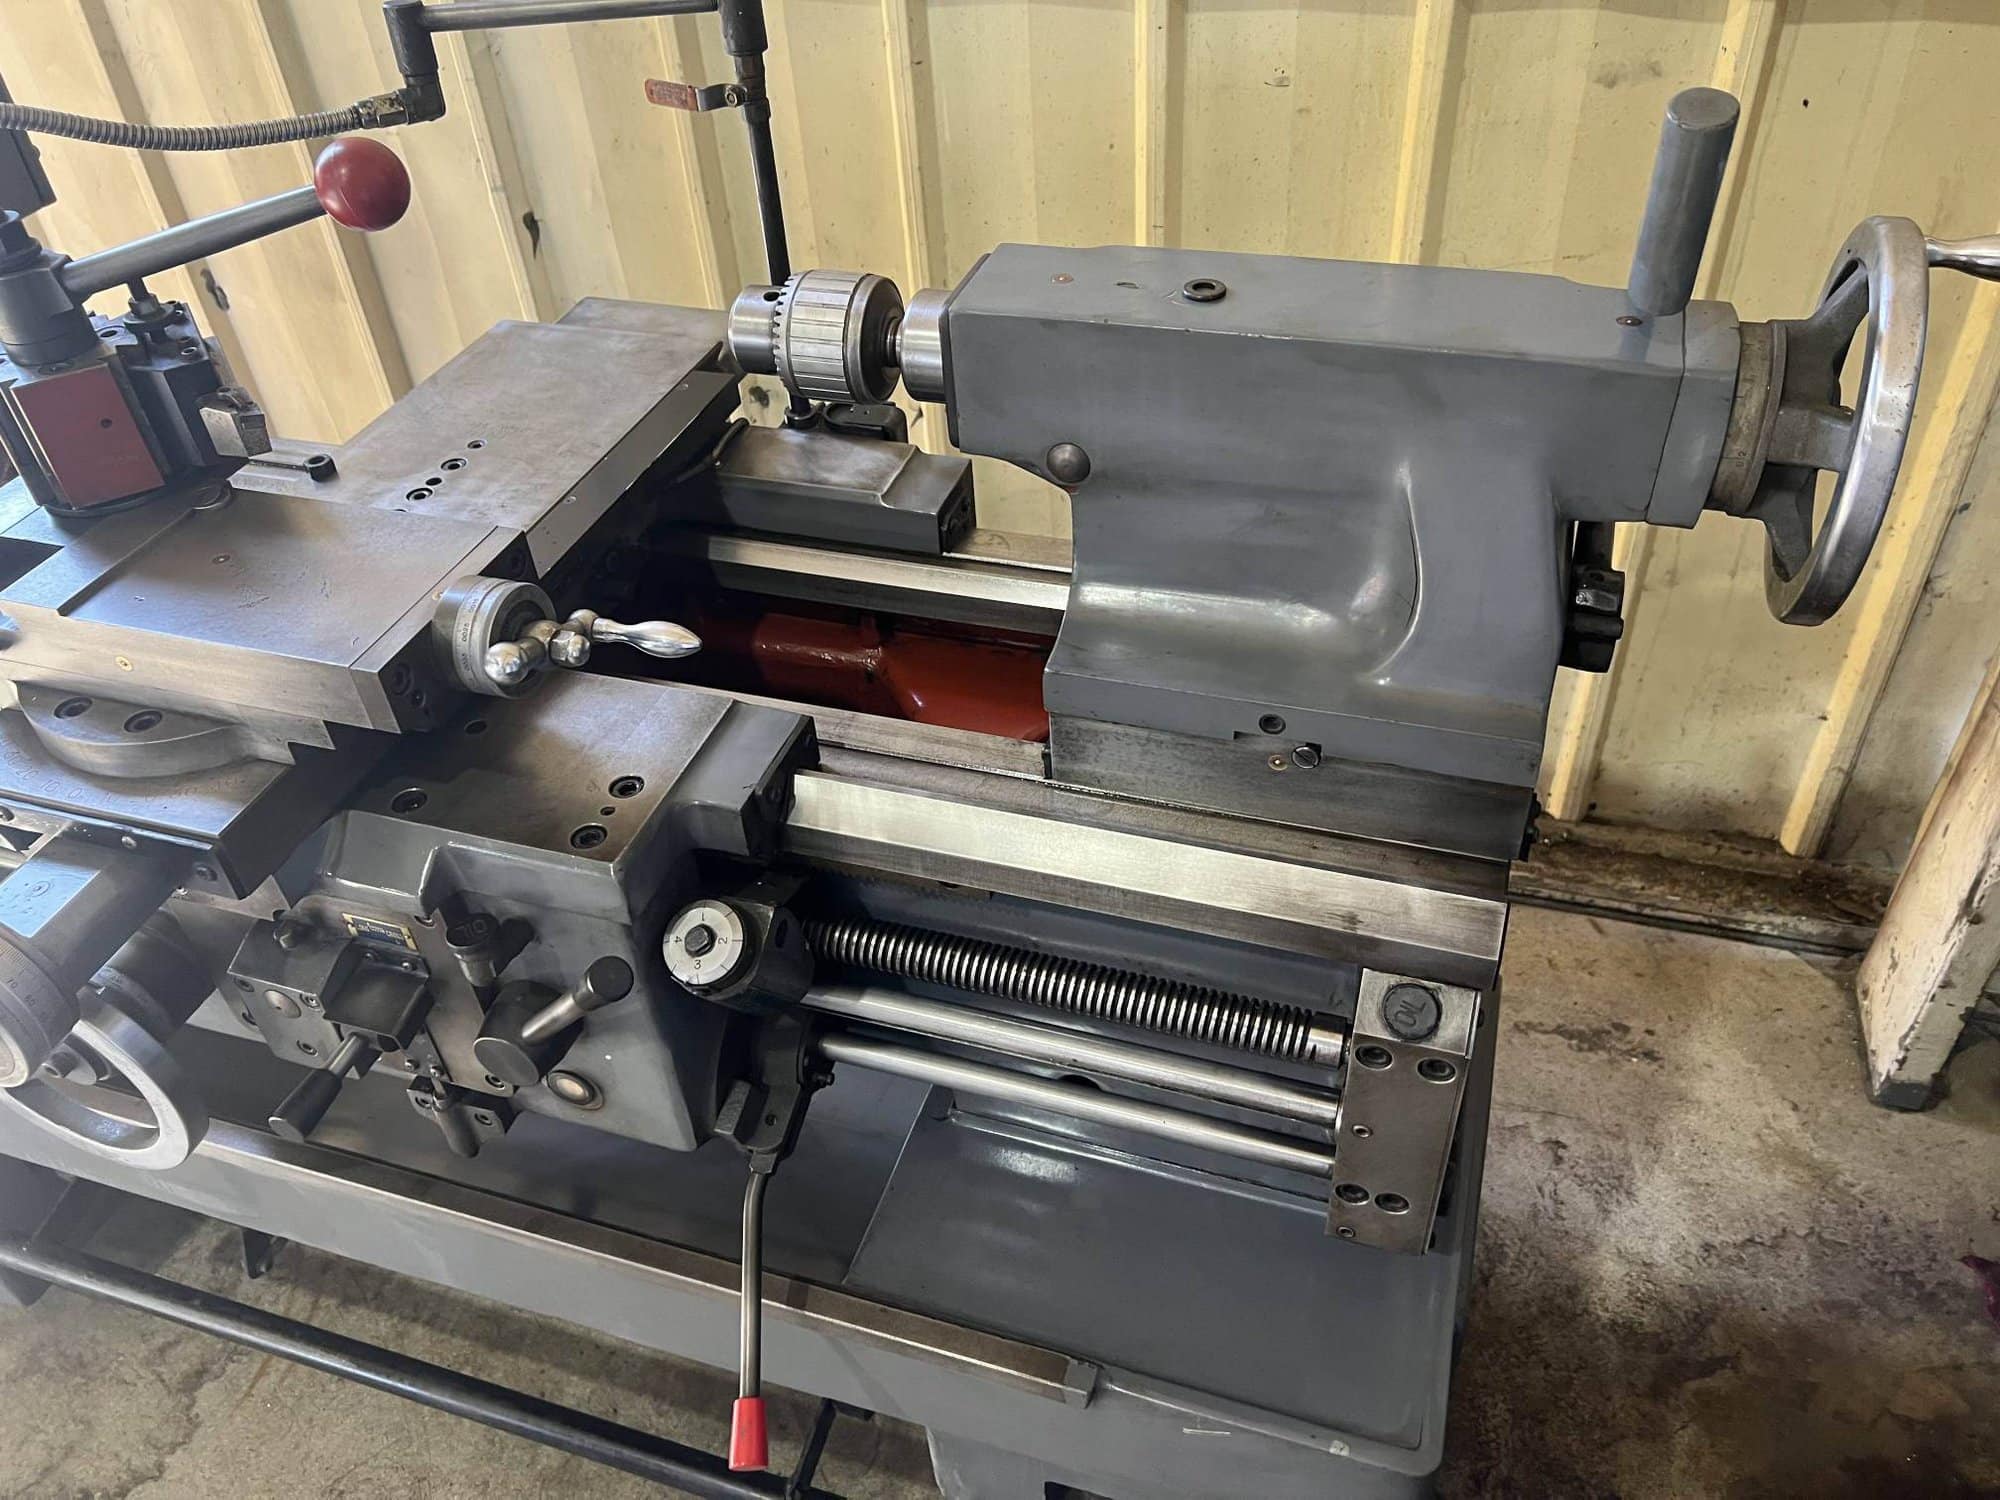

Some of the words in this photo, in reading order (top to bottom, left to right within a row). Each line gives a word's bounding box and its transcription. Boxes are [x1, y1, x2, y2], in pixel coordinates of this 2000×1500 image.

[717, 936, 728, 944] 2
[693, 959, 701, 970] 3
[1394, 1000, 1426, 1027] OIL
